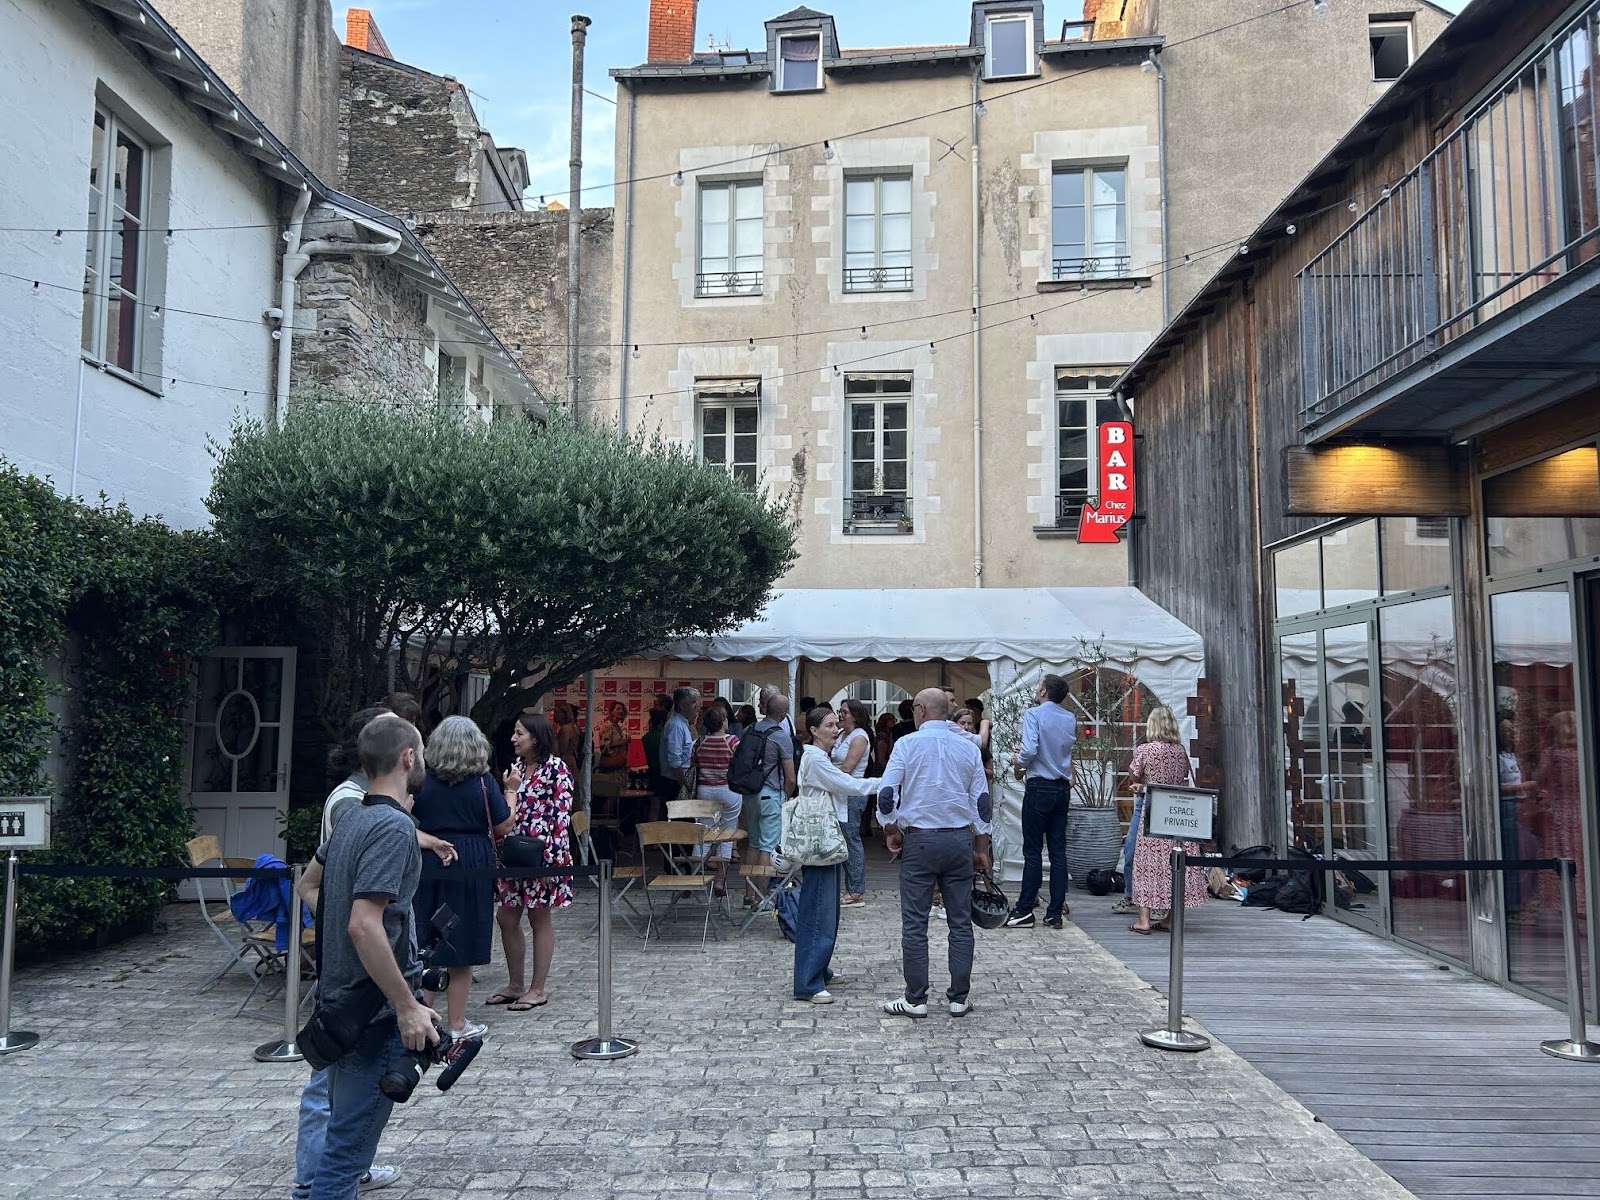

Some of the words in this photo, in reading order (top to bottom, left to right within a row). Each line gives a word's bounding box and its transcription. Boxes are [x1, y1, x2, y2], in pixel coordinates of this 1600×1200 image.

[1106, 427, 1128, 490] BAR
[1105, 501, 1126, 509] Chez
[1086, 511, 1127, 524] Marius
[1169, 806, 1195, 816] ESPACE
[1164, 817, 1199, 828] PRIVATISÉ
